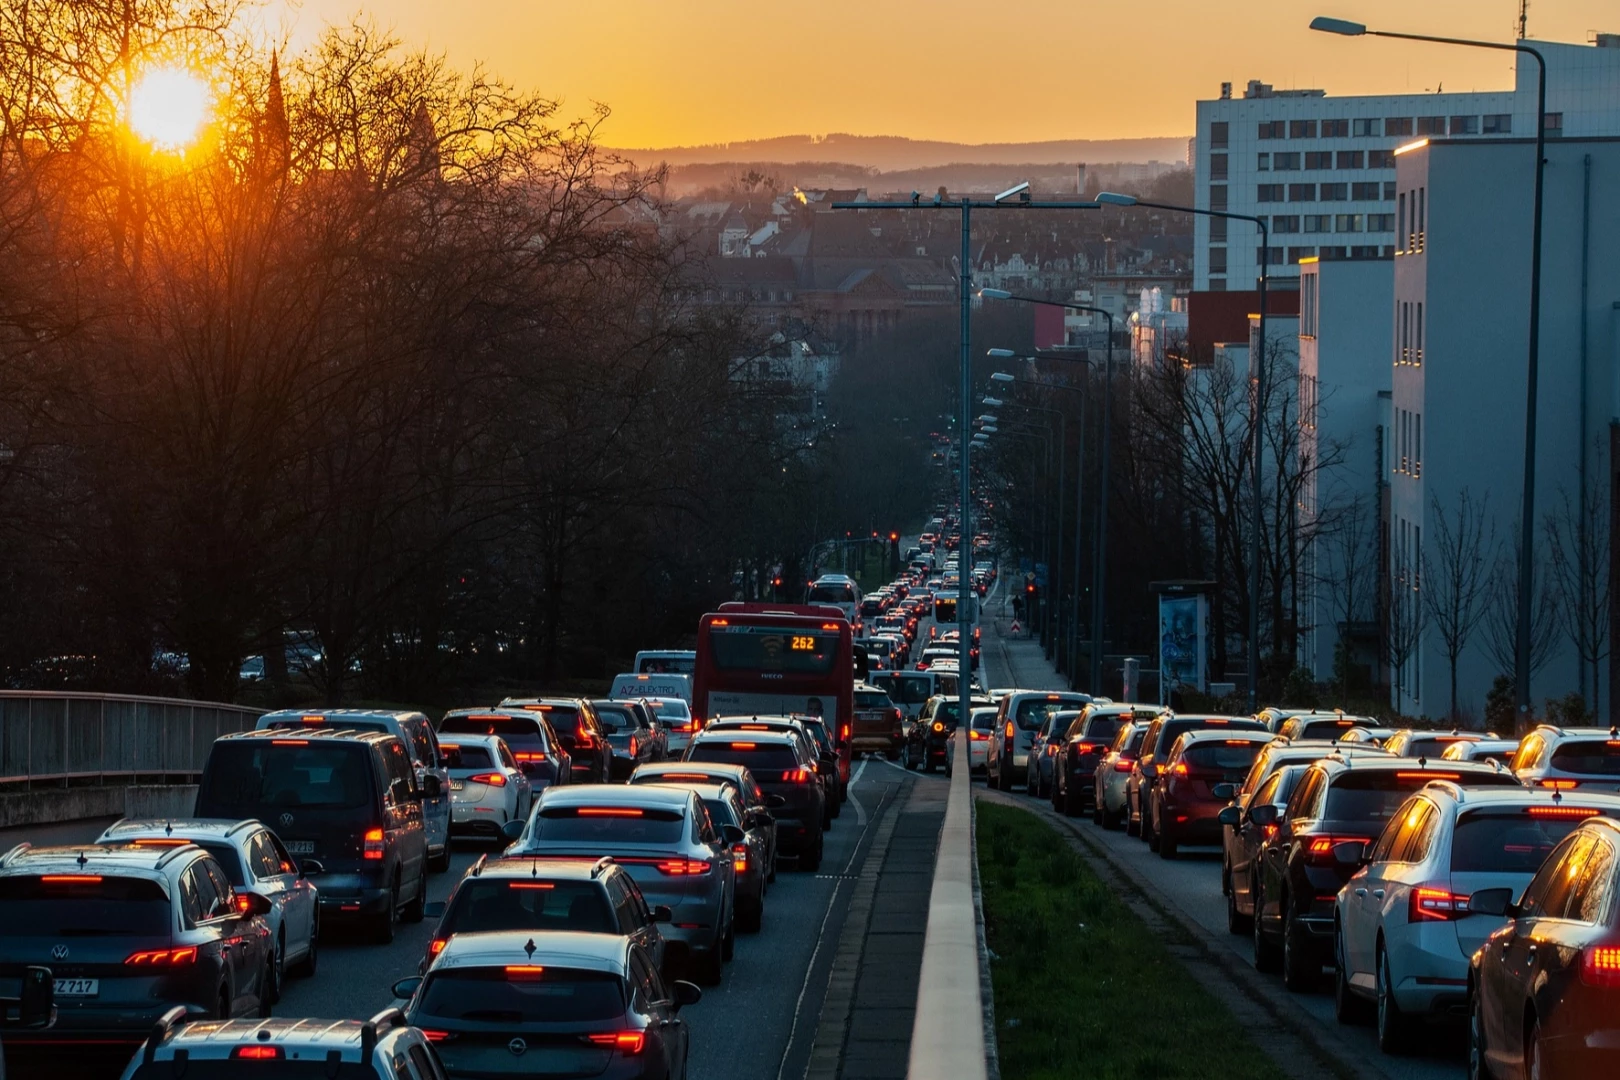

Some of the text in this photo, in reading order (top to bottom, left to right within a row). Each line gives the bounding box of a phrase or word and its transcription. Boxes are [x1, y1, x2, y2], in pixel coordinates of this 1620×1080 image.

[791, 636, 815, 650] 262
[297, 842, 313, 851] 213
[68, 980, 93, 993] 717
